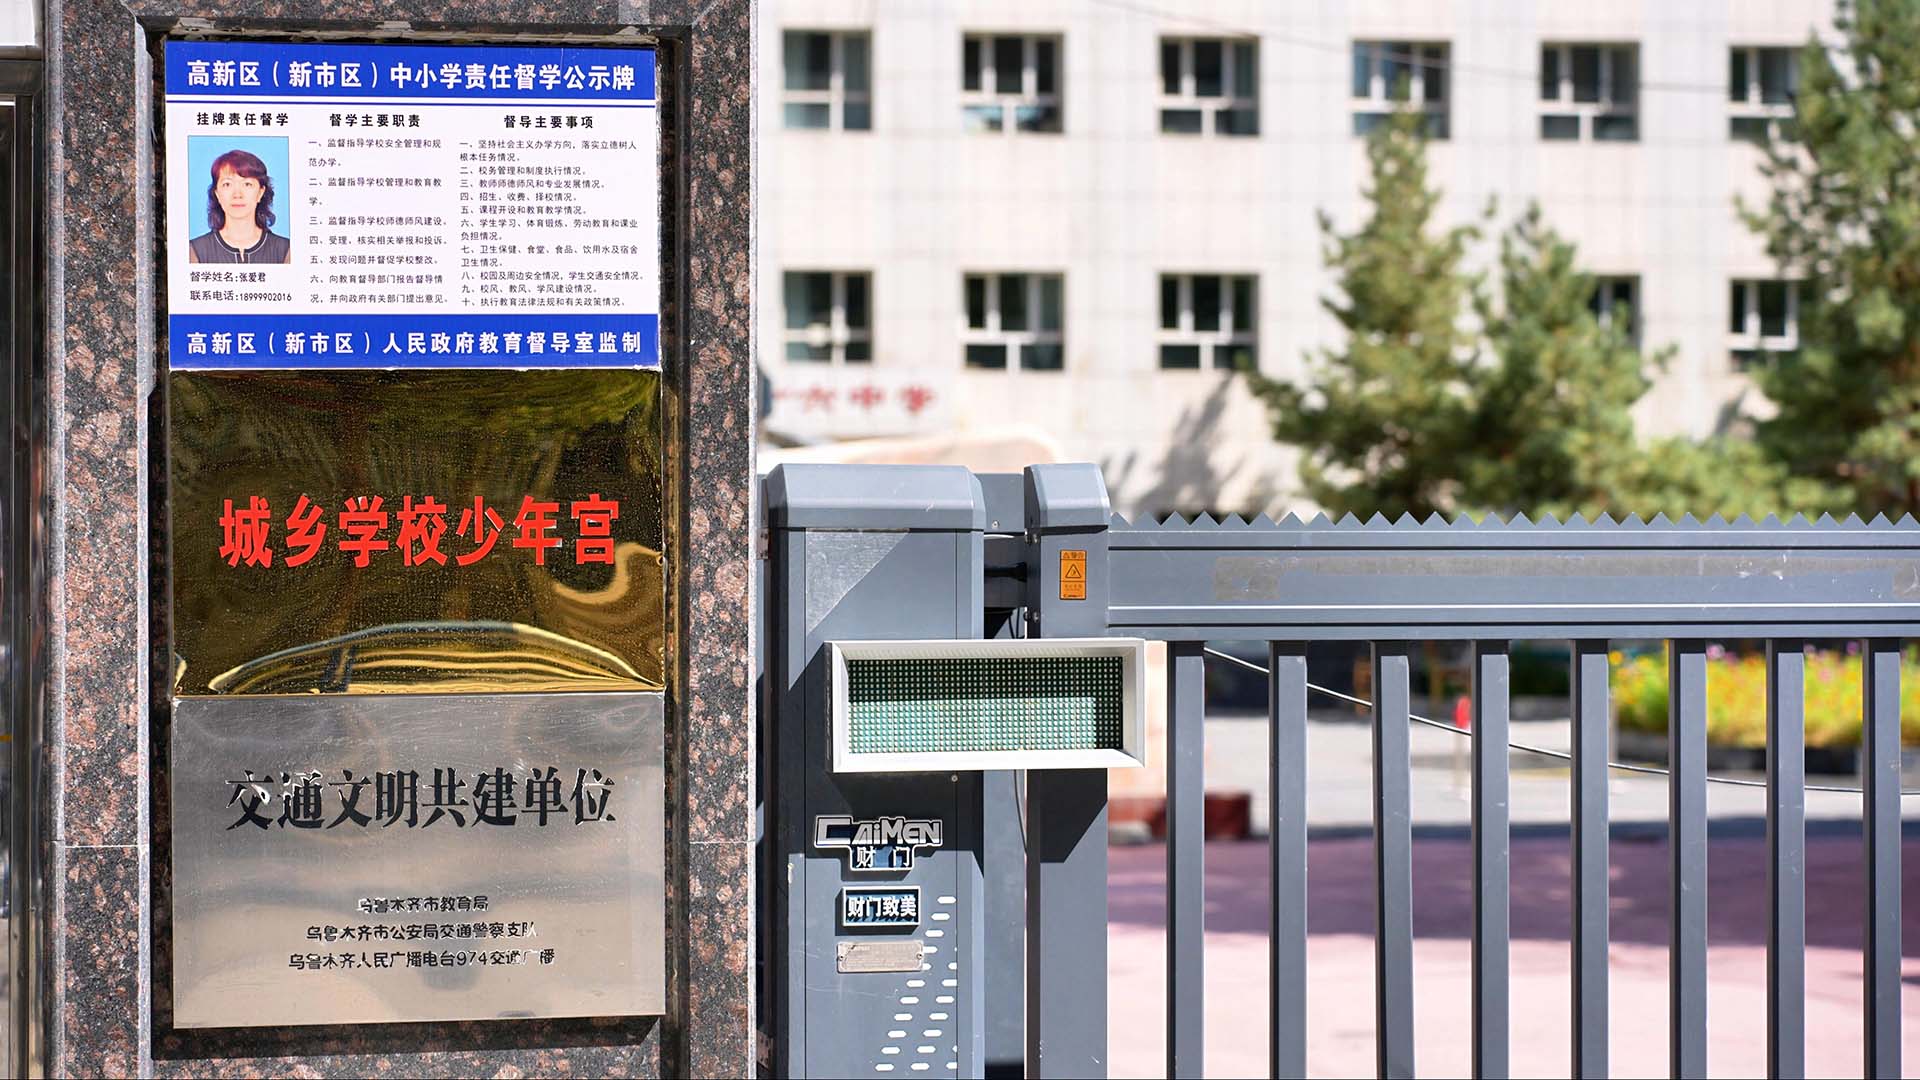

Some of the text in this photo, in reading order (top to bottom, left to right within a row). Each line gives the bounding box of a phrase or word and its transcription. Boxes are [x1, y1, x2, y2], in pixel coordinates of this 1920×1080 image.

[187, 59, 636, 91] 高新区（新市区）中小学责任督学公示牌
[197, 112, 289, 127] 挂牌责任督学
[329, 113, 421, 128] 督学主要职责
[503, 115, 594, 129] 督导主要事项
[186, 331, 641, 355] 高新区（新市区）人民政府教育督导室监制
[218, 494, 620, 568] 城乡学校少年宫
[225, 766, 616, 832] 交通文明共建单位
[356, 896, 489, 913] 乌鲁木齐市教育局
[847, 896, 917, 917] 财门致美
[306, 921, 538, 942] 乌鲁木齐市公安局交通警察支队
